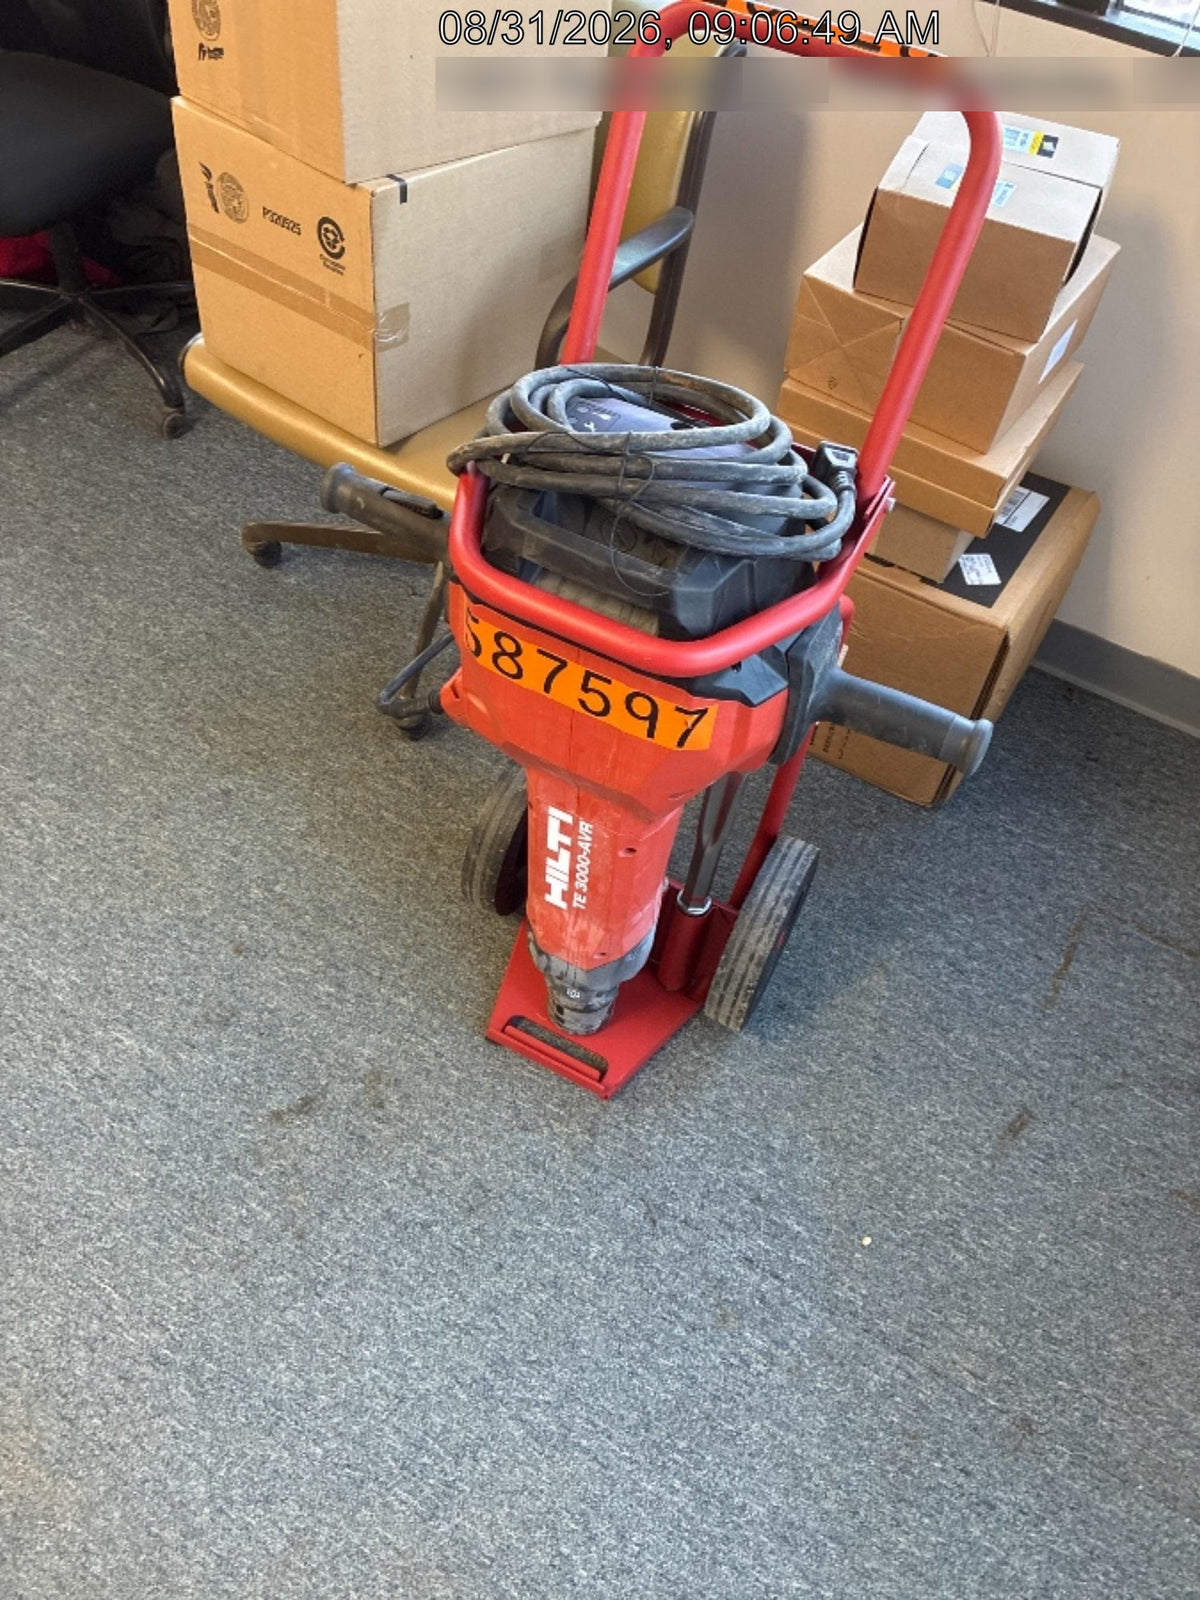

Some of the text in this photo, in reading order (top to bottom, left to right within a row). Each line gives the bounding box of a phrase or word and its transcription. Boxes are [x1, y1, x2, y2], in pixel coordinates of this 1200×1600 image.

[466, 605, 709, 749] 587597
[544, 805, 573, 910] HILTI
[572, 820, 593, 909] TE 3000-AVR
